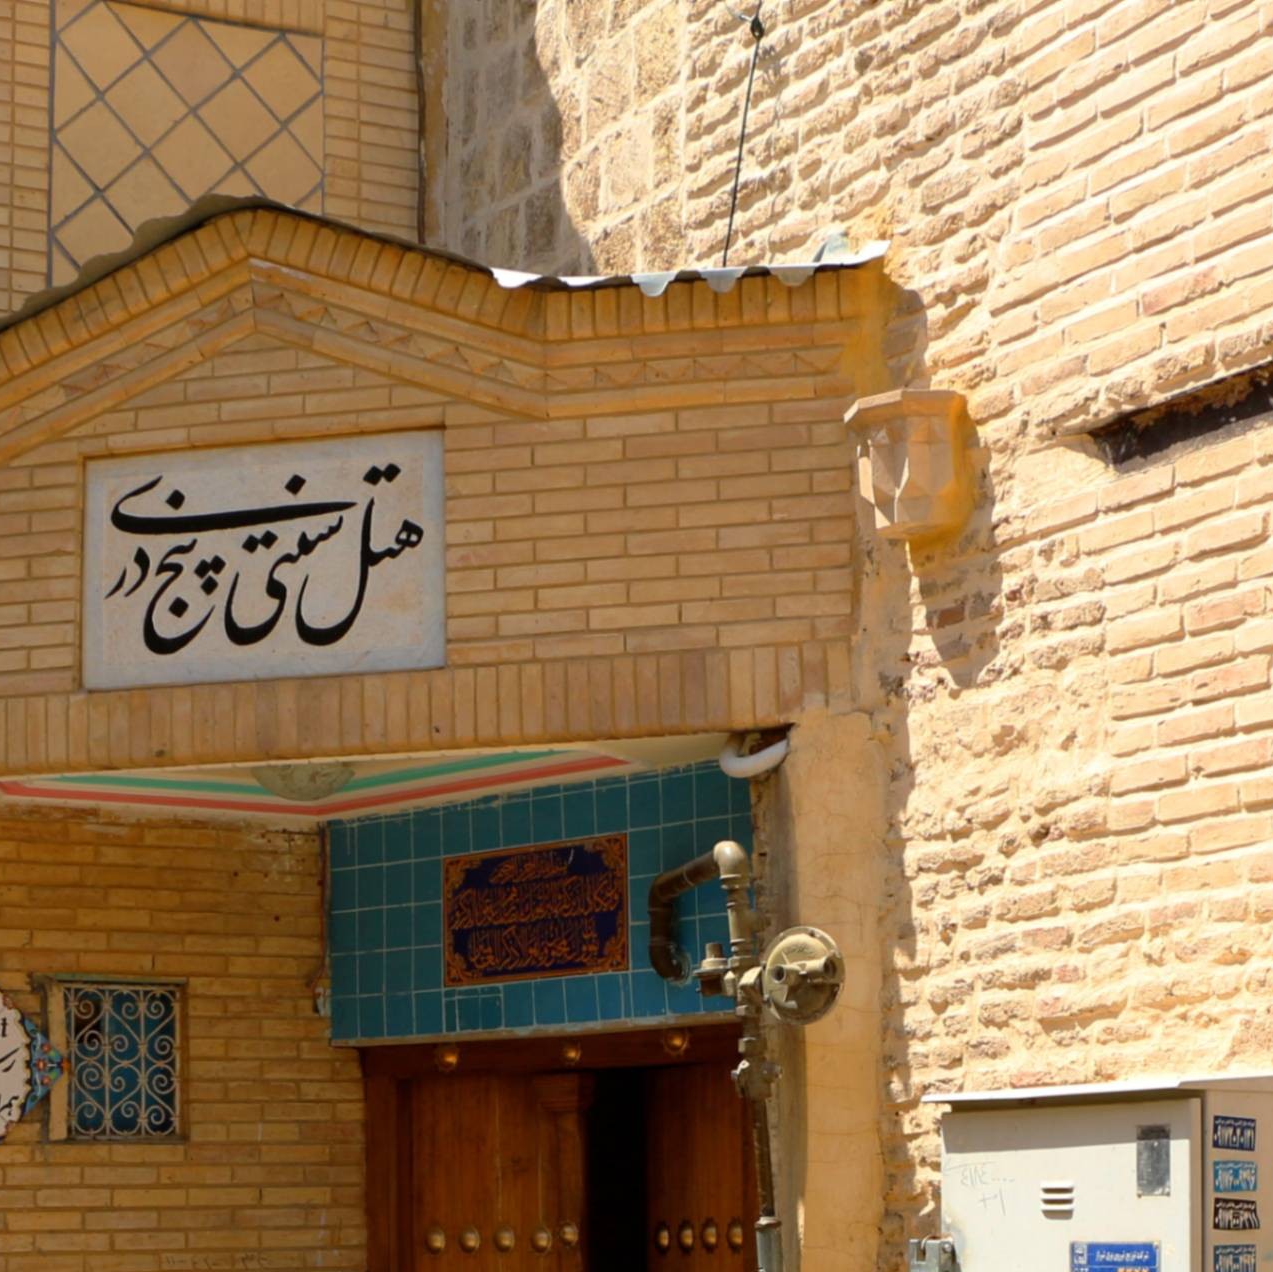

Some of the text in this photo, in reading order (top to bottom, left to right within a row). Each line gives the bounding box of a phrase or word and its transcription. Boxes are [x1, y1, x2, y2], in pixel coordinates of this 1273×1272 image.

[142, 489, 227, 655] پنج
[223, 474, 345, 646] سنتی
[294, 462, 424, 647] هتل
